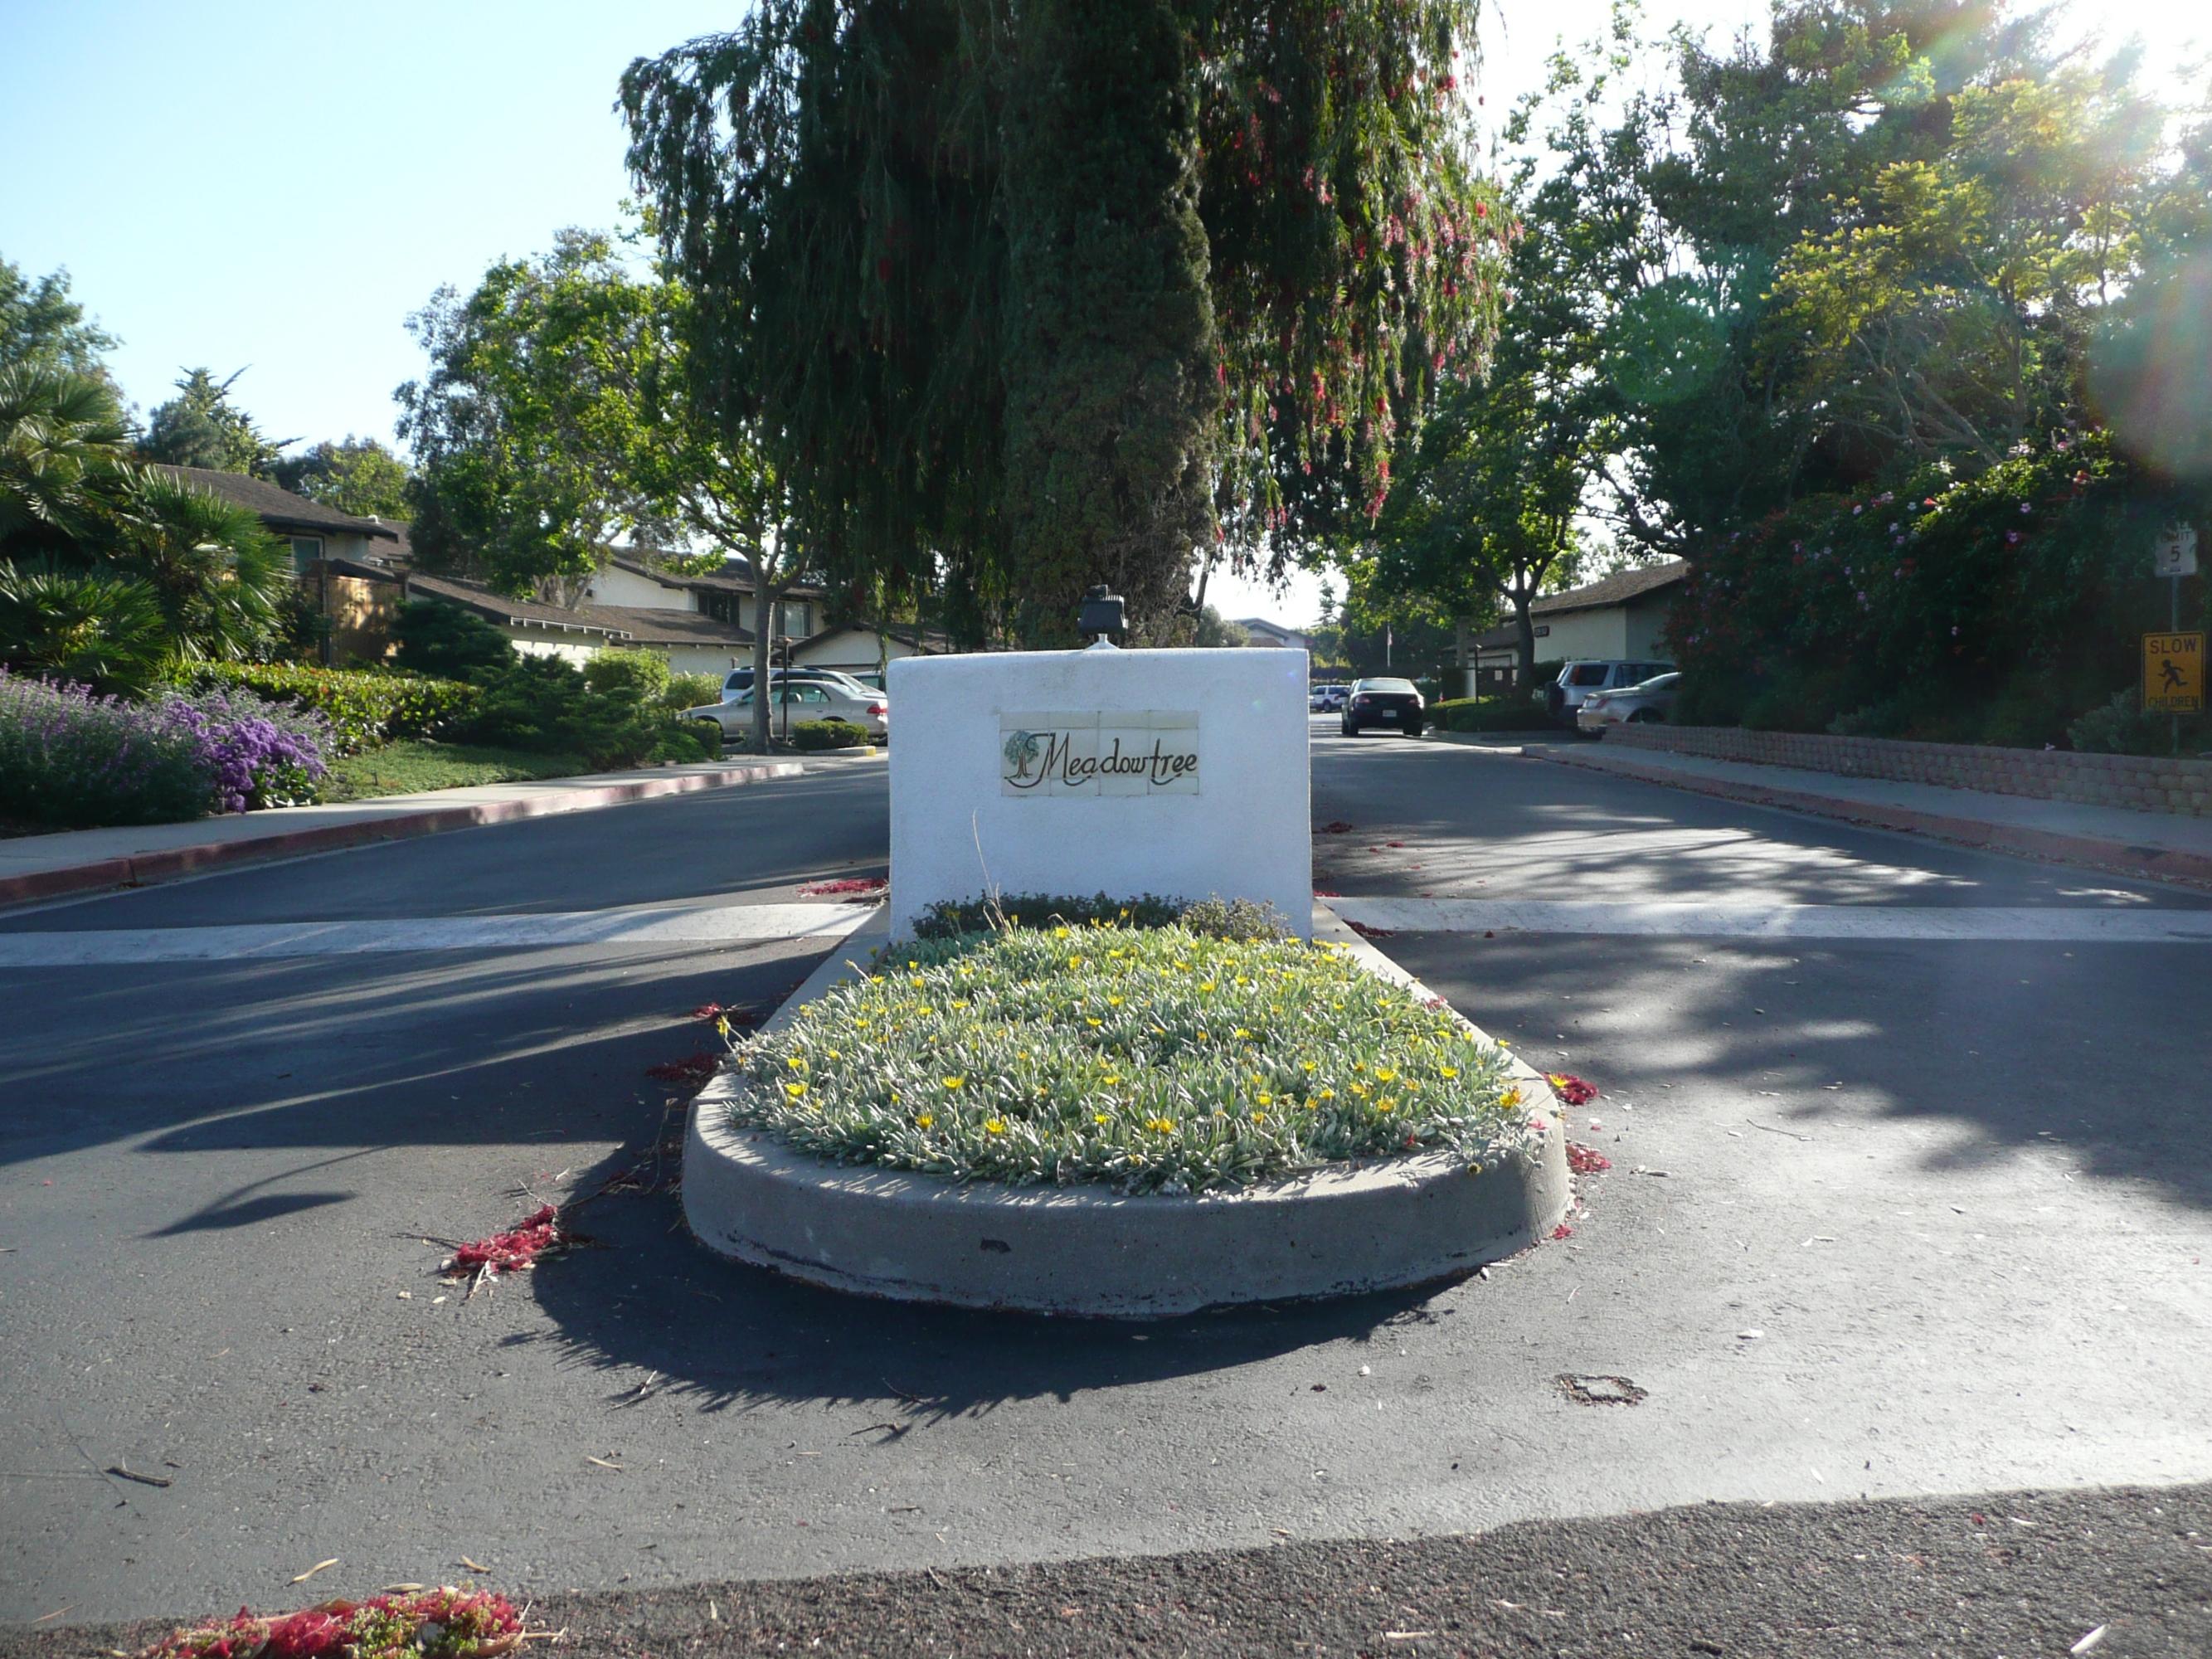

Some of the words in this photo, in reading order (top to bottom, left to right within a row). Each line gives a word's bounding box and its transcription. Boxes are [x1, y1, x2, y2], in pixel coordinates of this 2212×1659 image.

[2170, 545, 2180, 562] 5
[2150, 637, 2197, 654] SLOW
[2148, 695, 2199, 708] CHILDREN
[1004, 732, 1197, 788] Meadowtree
